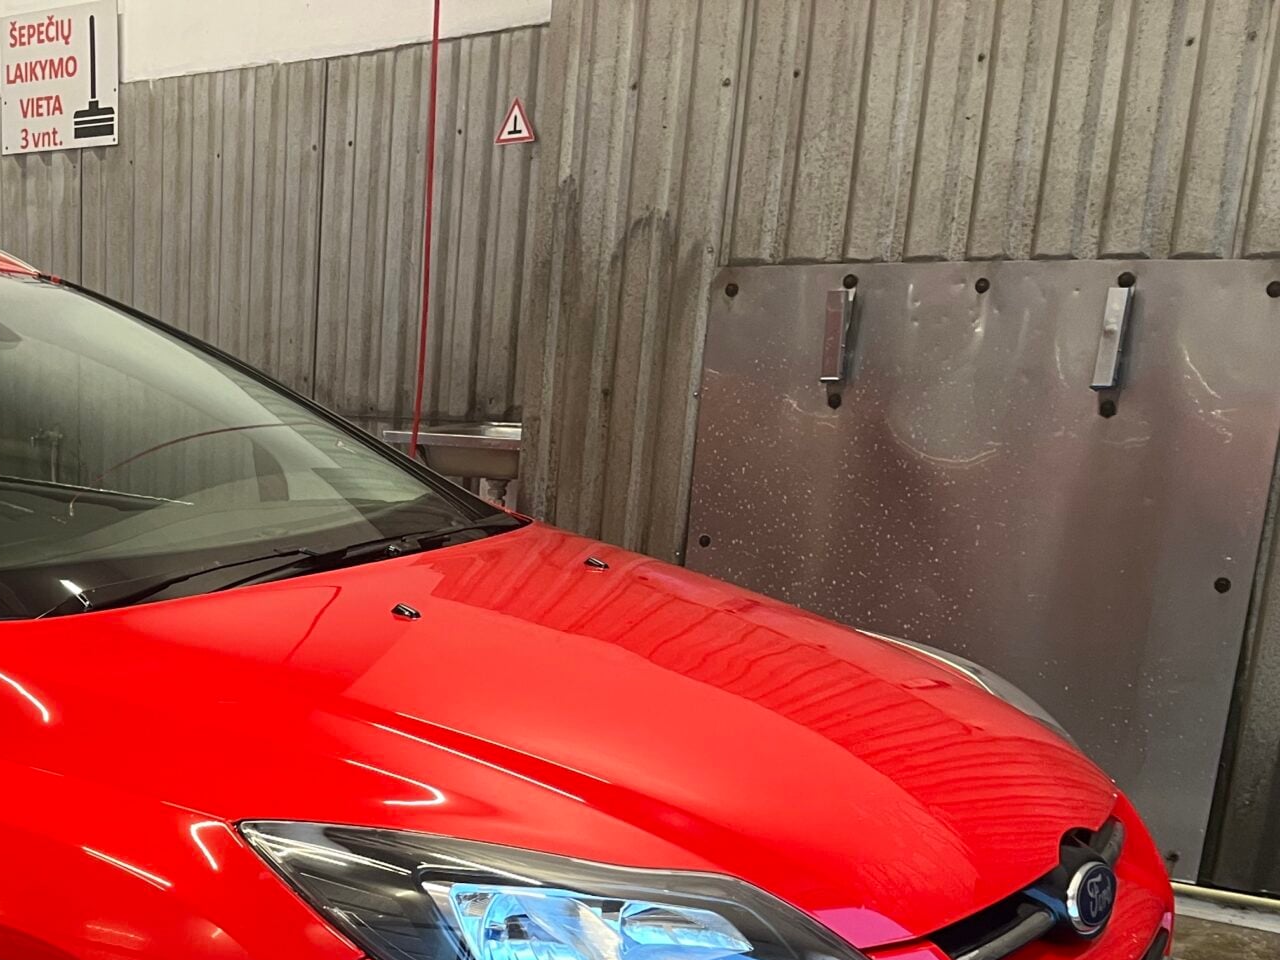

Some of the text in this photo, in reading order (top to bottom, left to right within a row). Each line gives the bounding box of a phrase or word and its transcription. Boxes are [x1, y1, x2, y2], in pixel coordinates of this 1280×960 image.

[9, 15, 72, 48] ŠEPEČIŲ
[6, 56, 77, 84] LAIKYMO
[20, 95, 63, 118] VIETA
[20, 127, 63, 149] 3 vnt.
